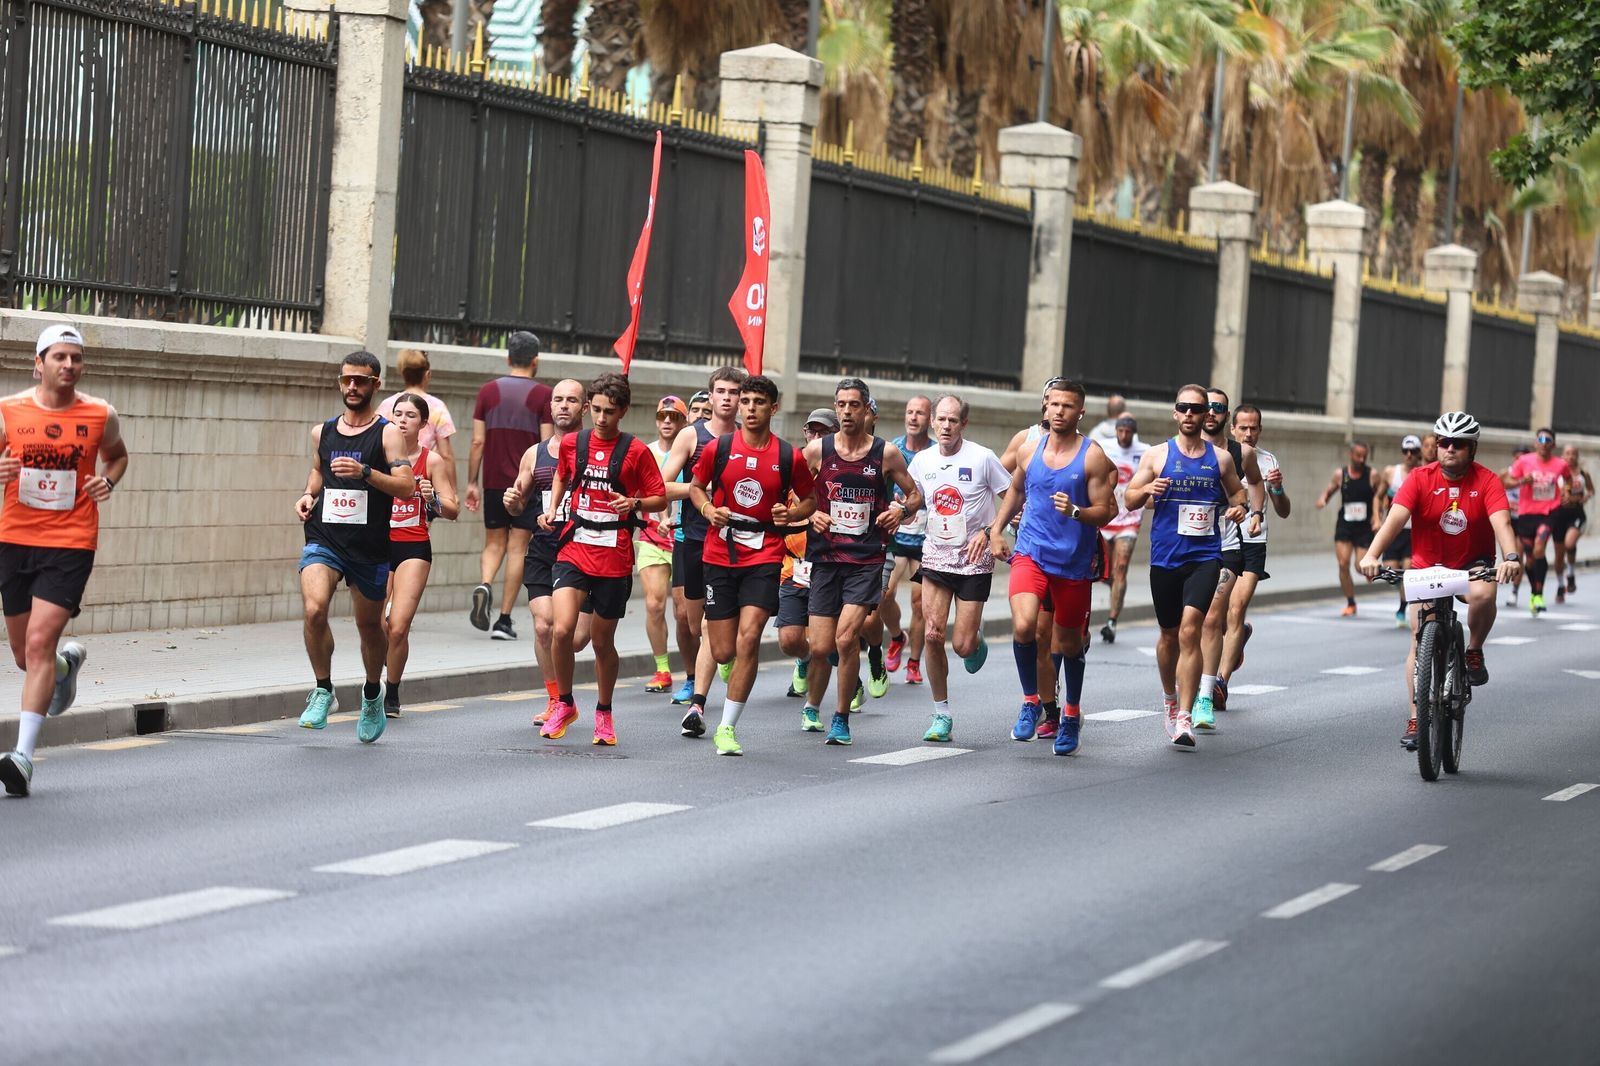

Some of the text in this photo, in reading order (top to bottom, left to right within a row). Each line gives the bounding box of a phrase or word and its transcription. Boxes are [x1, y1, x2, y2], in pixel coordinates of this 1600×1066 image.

[38, 480, 57, 490] 67
[740, 484, 759, 496] PONLE
[737, 489, 757, 501] FRENO
[936, 492, 961, 505] PONLE
[332, 498, 357, 508] 406
[936, 499, 959, 511] FRENO
[837, 510, 866, 520] 1074
[943, 523, 949, 531] 1
[1408, 572, 1463, 583] CLASIFICADA
